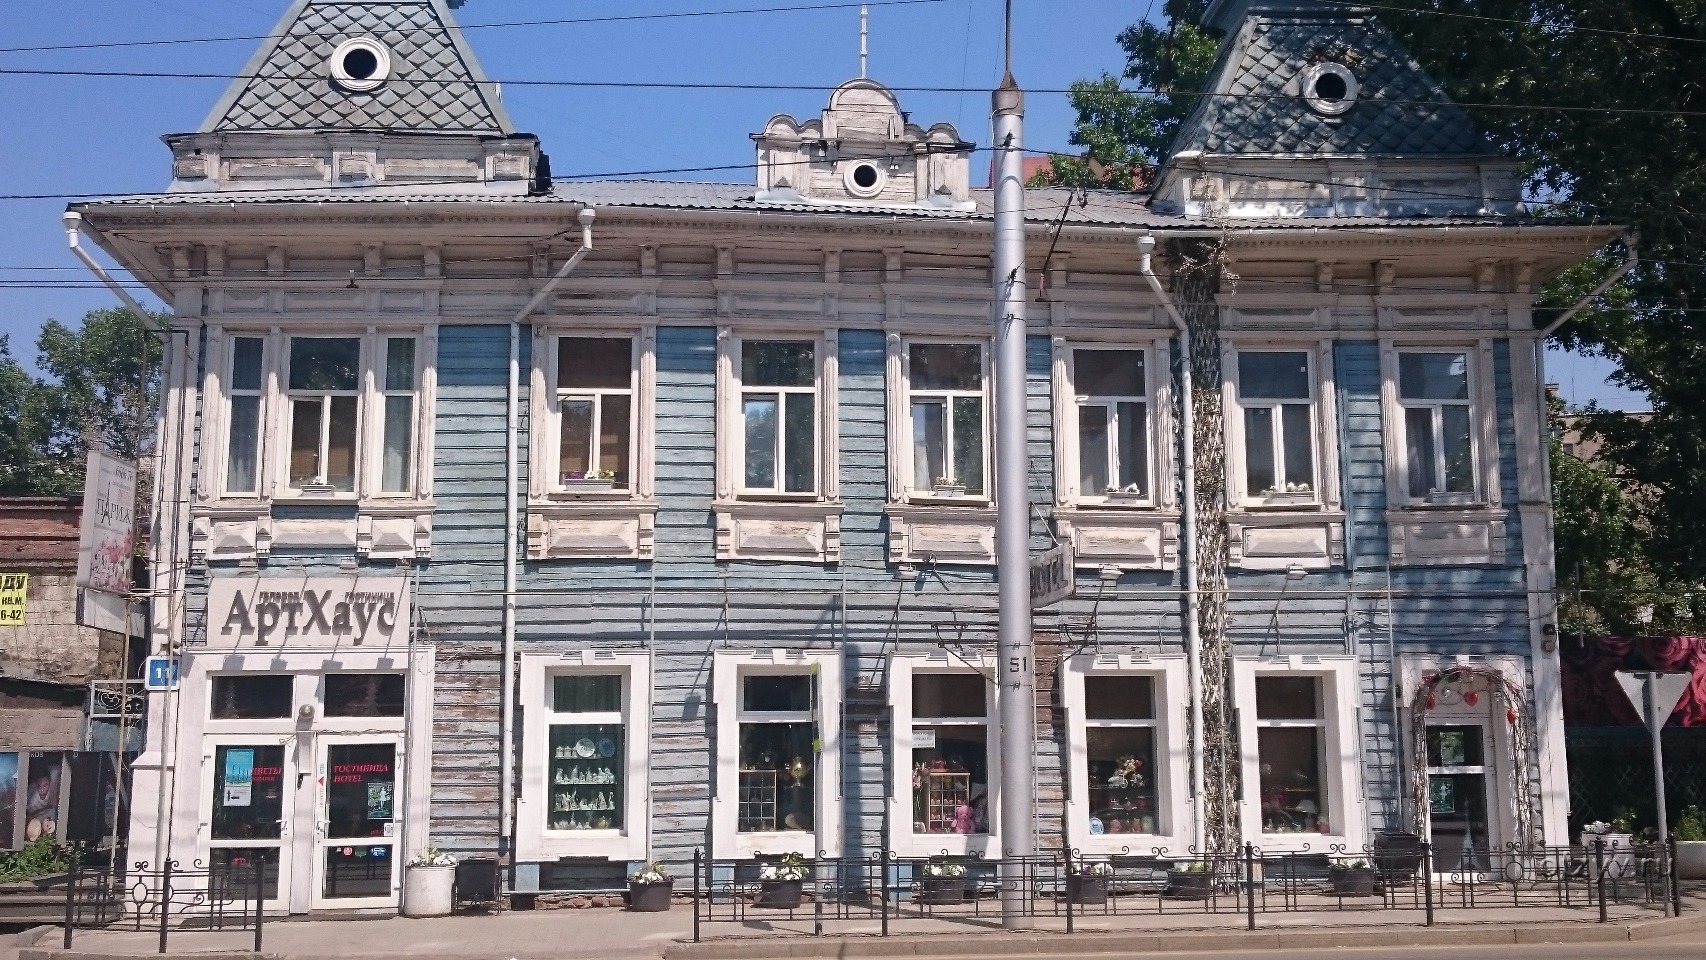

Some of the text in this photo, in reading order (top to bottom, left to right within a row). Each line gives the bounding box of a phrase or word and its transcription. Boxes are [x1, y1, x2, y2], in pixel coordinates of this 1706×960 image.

[0, 576, 26, 591] ДУ
[221, 590, 395, 646] АртХаус
[1010, 657, 1026, 673] 51
[333, 764, 389, 773] ГОСТИНИЦА
[333, 774, 364, 783] HOTEL
